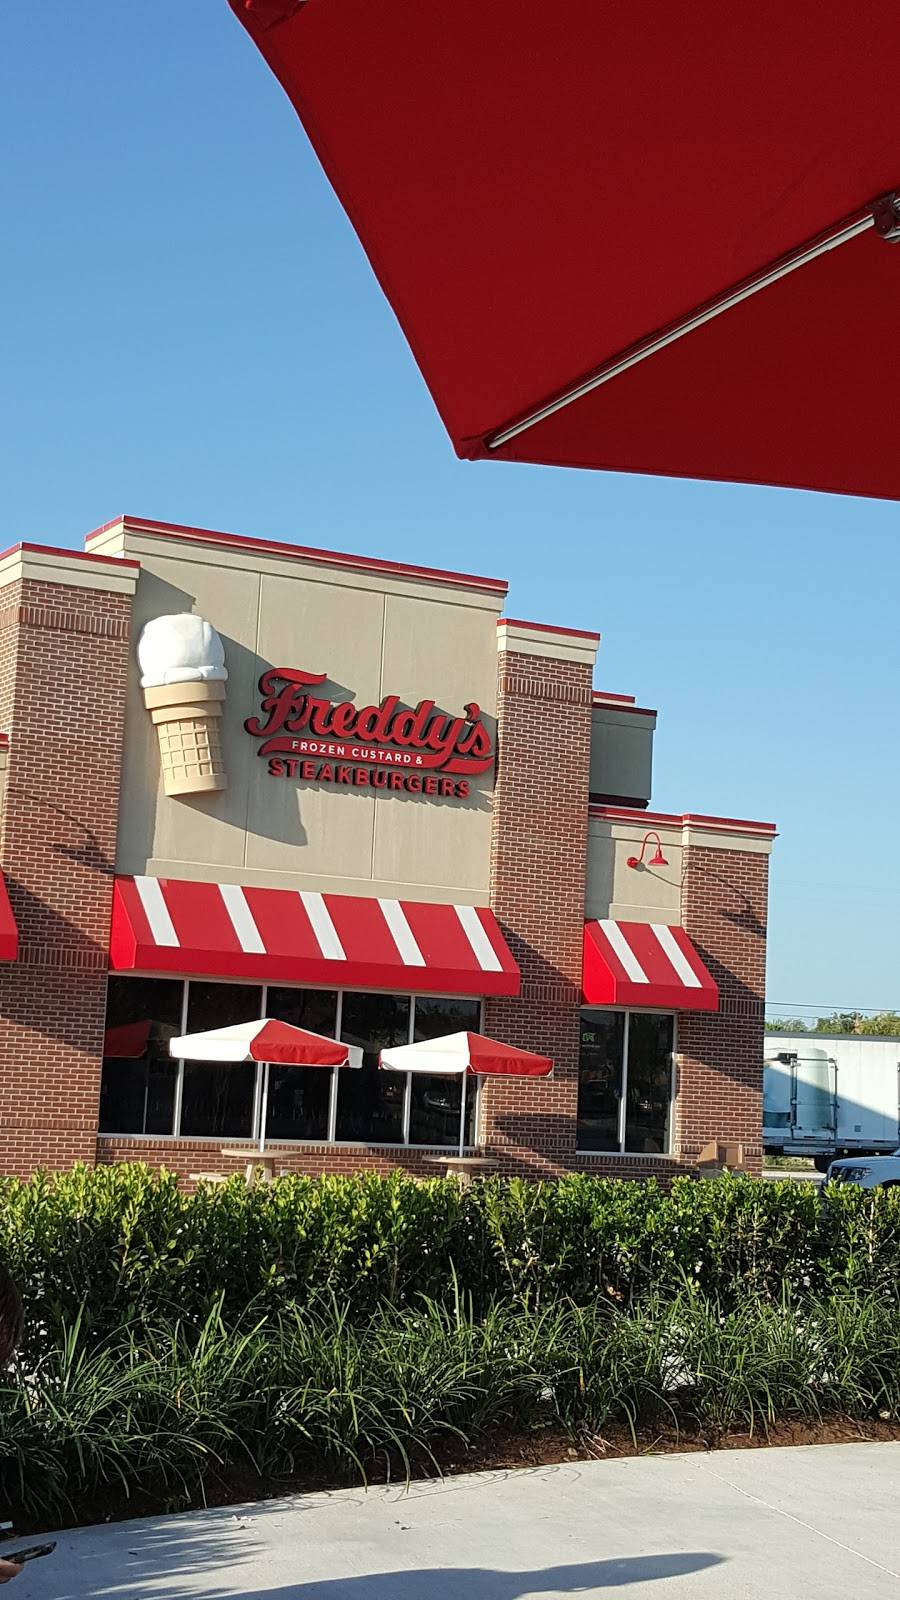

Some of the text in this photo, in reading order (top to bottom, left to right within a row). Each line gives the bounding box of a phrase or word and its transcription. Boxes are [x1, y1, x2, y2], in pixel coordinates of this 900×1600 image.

[244, 667, 491, 764] Freddy's
[291, 740, 424, 765] FROZEN CUSTARD &
[268, 757, 471, 799] STEAKBURGERS
